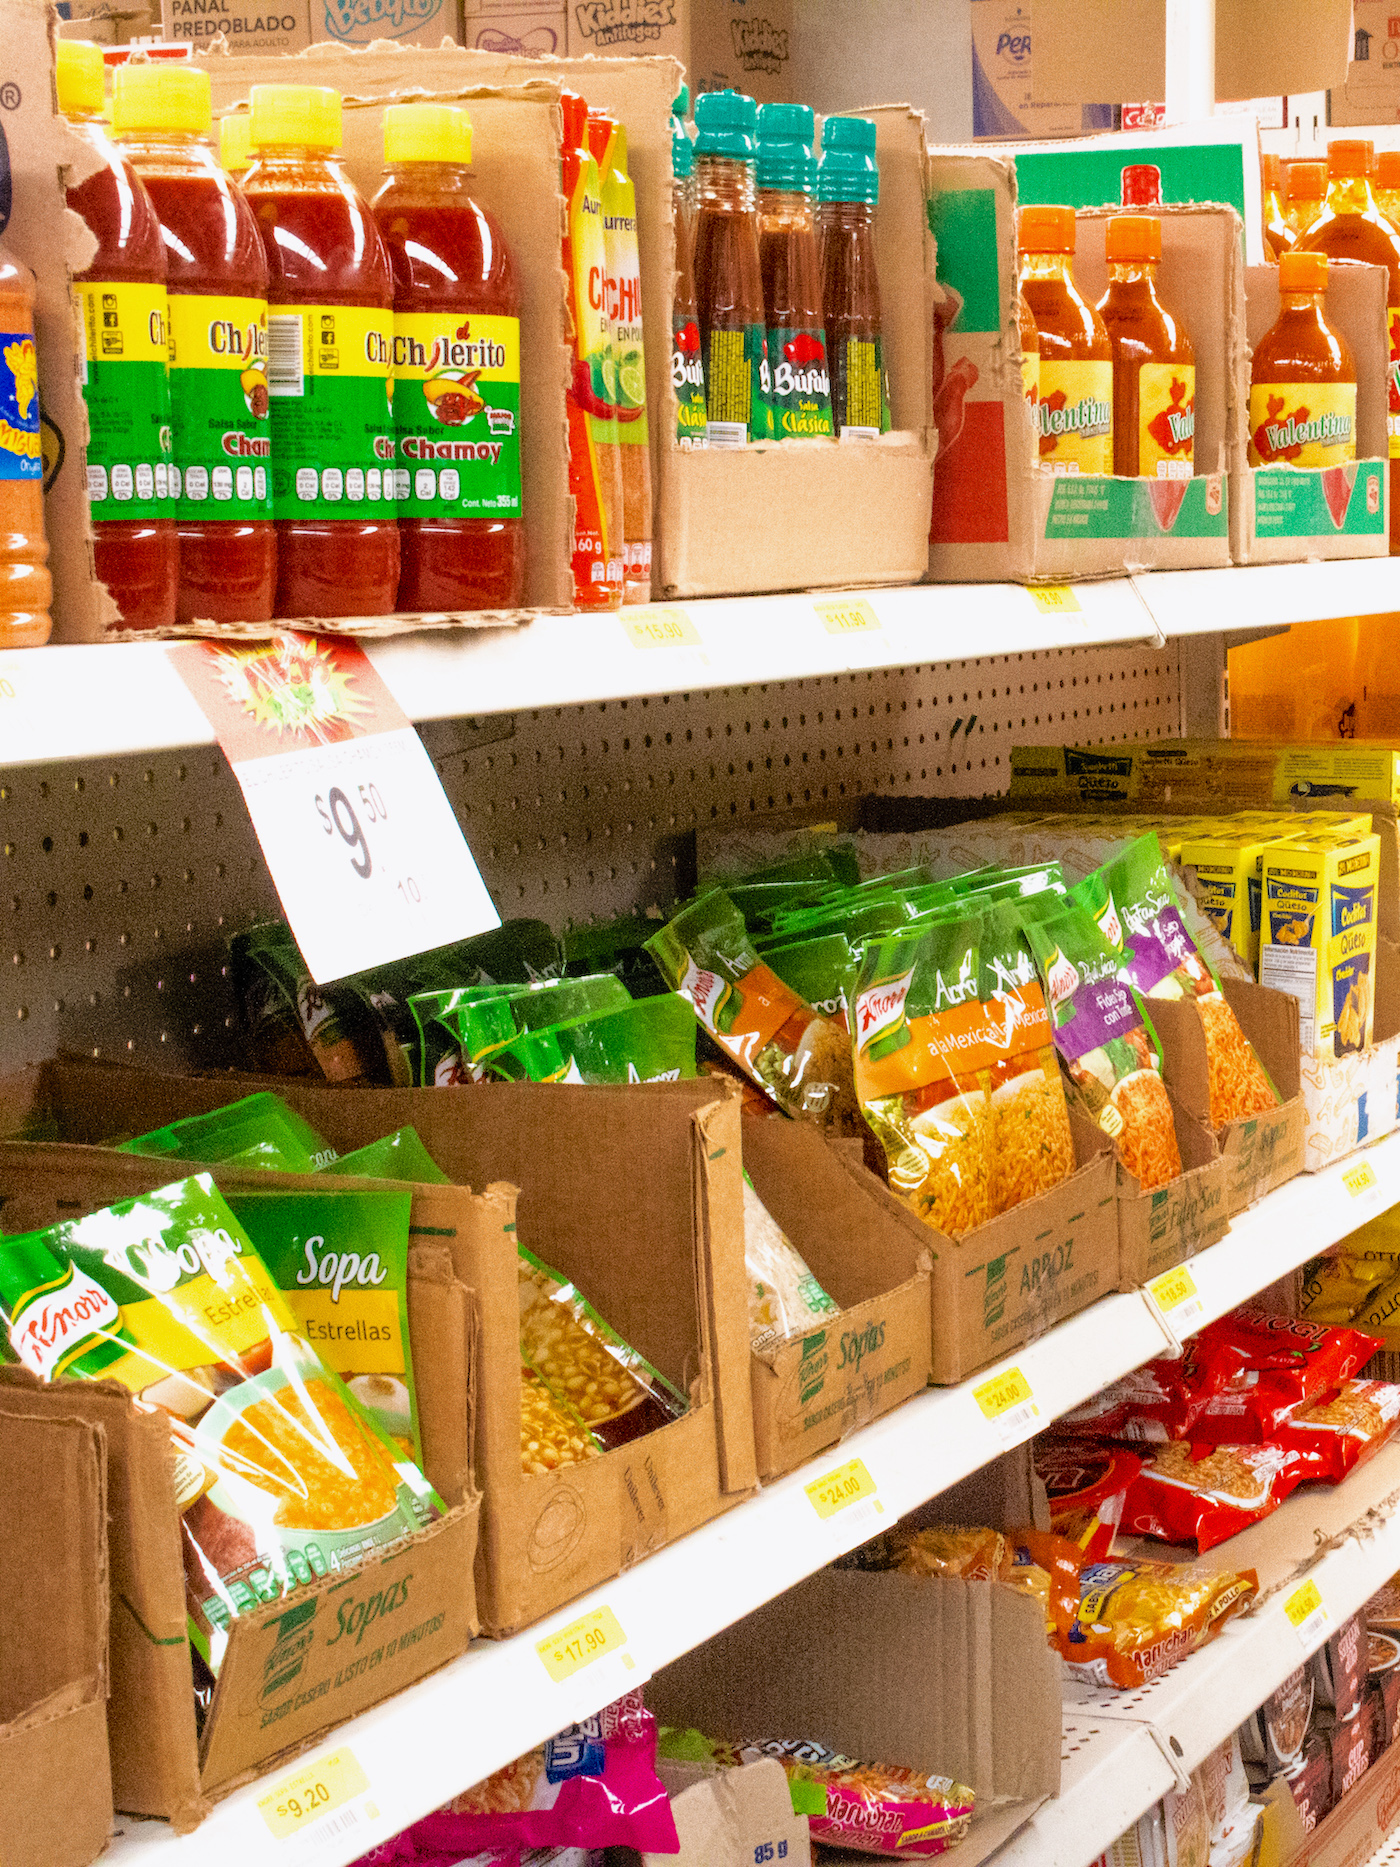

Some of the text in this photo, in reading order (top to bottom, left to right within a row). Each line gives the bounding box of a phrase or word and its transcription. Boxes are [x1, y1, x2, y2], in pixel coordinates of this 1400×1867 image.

[173, 15, 296, 38] PREDOBLADO
[781, 408, 831, 435] Clásica
[1265, 411, 1351, 452] Valentina
[401, 436, 504, 466] Chamoy
[1277, 887, 1308, 900] Coditos
[1341, 902, 1367, 928] Coditos
[858, 985, 907, 1033] Knorr
[296, 1234, 388, 1304] Sopa
[1018, 1238, 1075, 1298] ARROZ
[203, 1285, 275, 1326] Estrellas
[1160, 1281, 1188, 1303] $18.50
[19, 1287, 109, 1365] Knorr
[305, 1319, 392, 1342] Estrellas
[836, 1318, 887, 1375] Sopas
[985, 1383, 1020, 1409] $24.00
[819, 1476, 860, 1506] $24.00
[326, 1573, 414, 1647] Sopas
[1218, 1586, 1241, 1608] POLLO
[554, 1628, 606, 1662] $17.90
[276, 1783, 330, 1818] $9.20
[826, 1791, 906, 1834] Maruchan
[753, 1841, 775, 1864] 85
